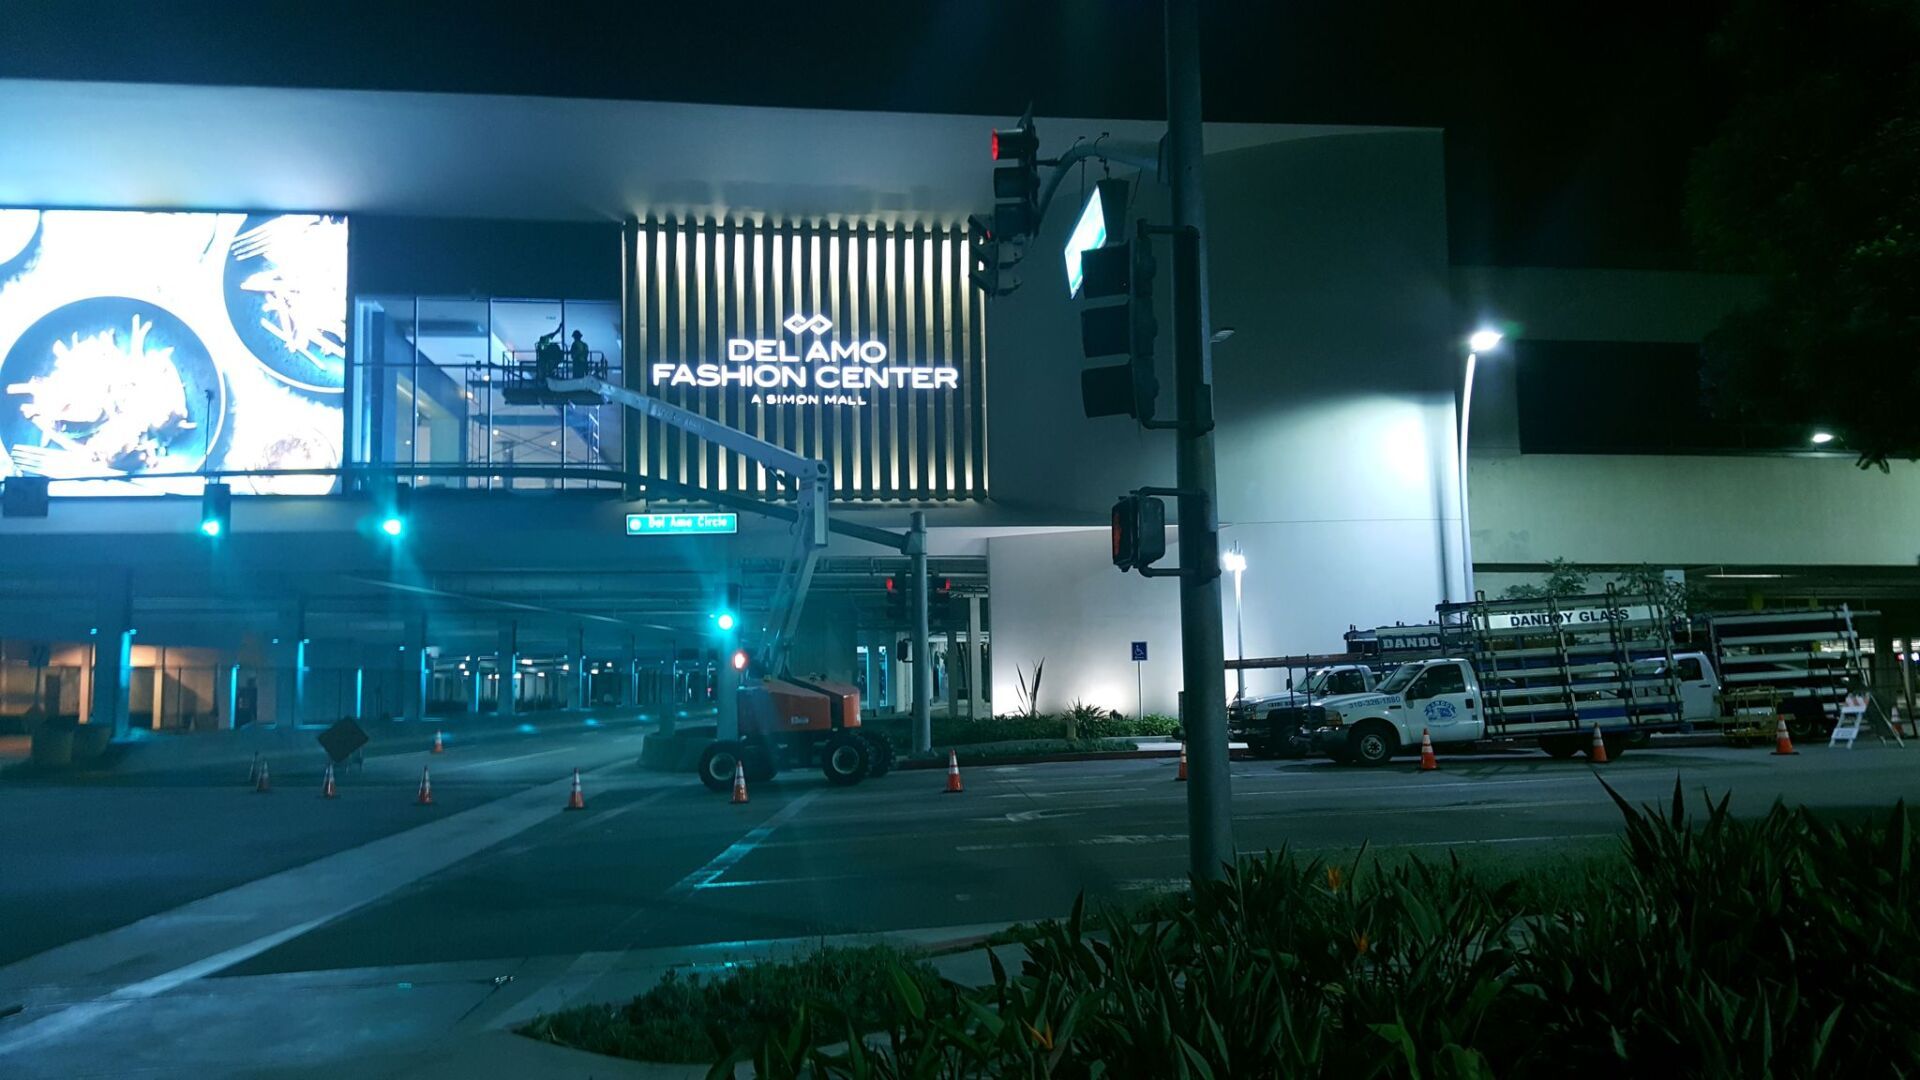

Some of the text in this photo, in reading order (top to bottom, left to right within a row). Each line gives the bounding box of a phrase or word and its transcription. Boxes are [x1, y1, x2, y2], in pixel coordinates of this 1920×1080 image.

[728, 339, 887, 364] DEL AMO
[652, 363, 958, 390] FASHION CENTER
[751, 394, 867, 406] A SIMON MALL
[648, 514, 727, 528] Del Amo Circle
[1510, 609, 1629, 627] DANDOY GLASS
